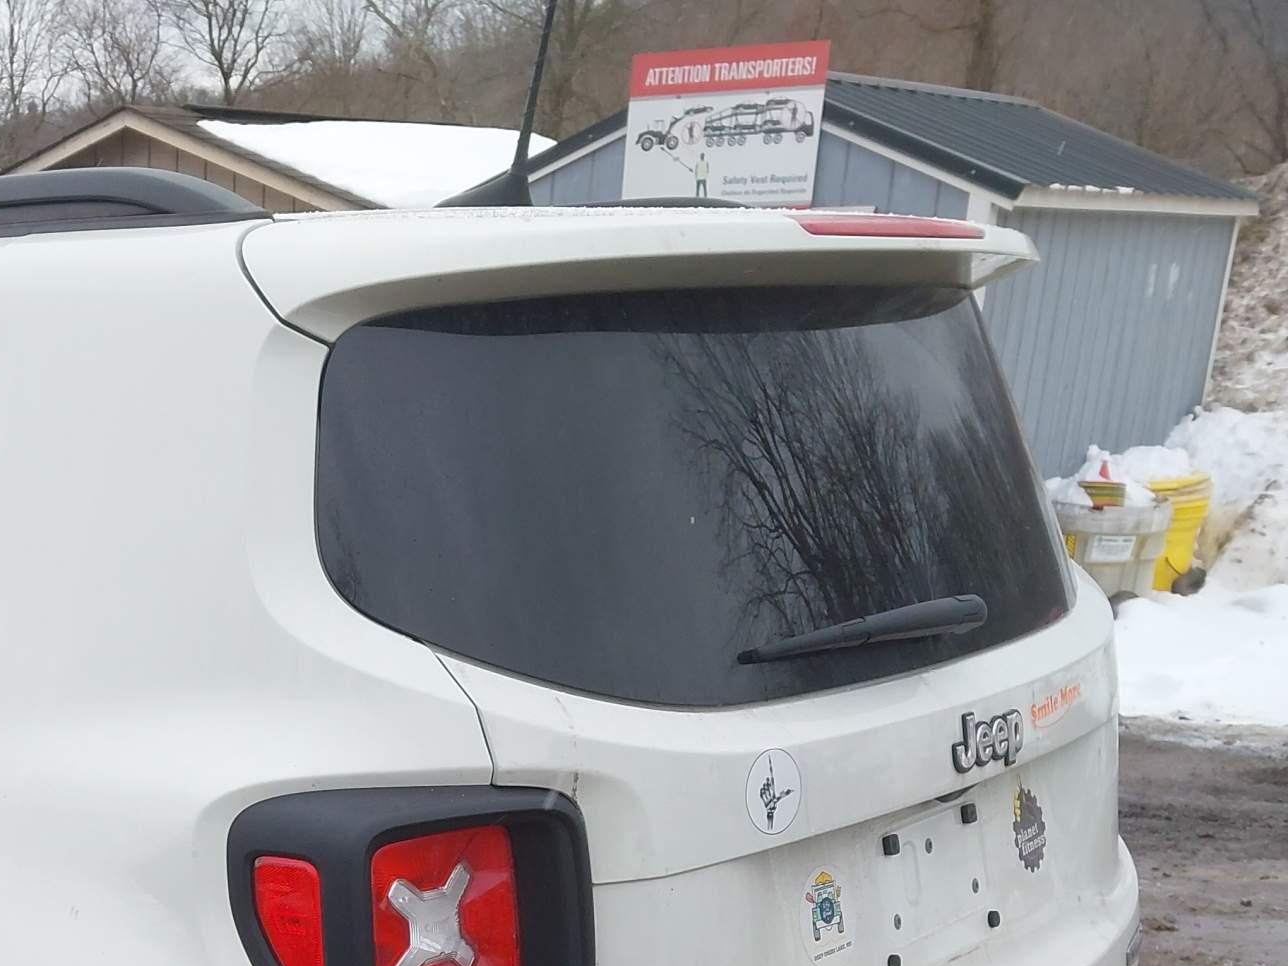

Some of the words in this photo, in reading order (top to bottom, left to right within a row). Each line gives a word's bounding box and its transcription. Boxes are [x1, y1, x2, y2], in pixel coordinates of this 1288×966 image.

[645, 64, 711, 86] ATTENTION
[715, 57, 816, 81] TRANSPORTERS!
[1031, 694, 1059, 722] Smile
[952, 708, 1024, 774] Jeep
